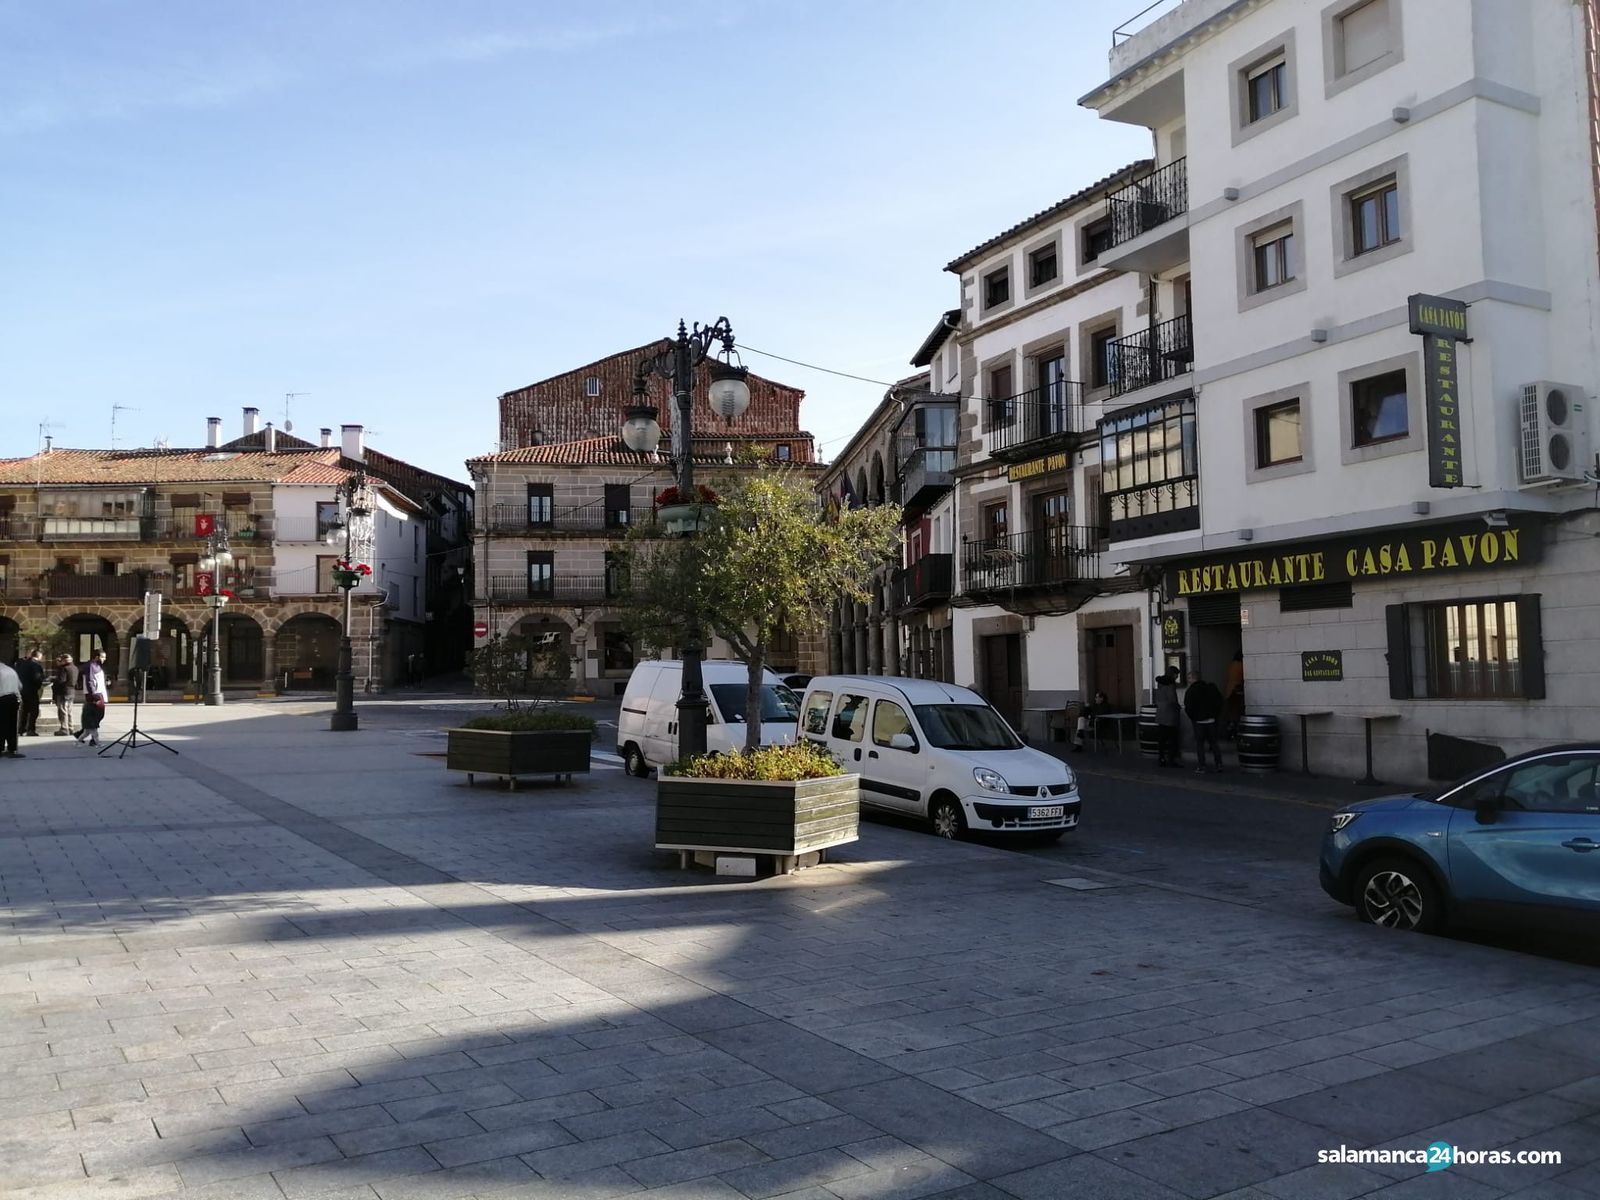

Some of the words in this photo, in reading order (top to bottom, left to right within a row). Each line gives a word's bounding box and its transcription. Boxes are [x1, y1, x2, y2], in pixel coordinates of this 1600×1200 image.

[1419, 304, 1437, 327] CASA
[1437, 338, 1459, 484] RESTAURANTE
[1009, 459, 1045, 480] RESTAURANTE
[1177, 552, 1325, 595] RESTAURANTE
[1346, 543, 1412, 577] CASA
[1032, 807, 1050, 817] 5362
